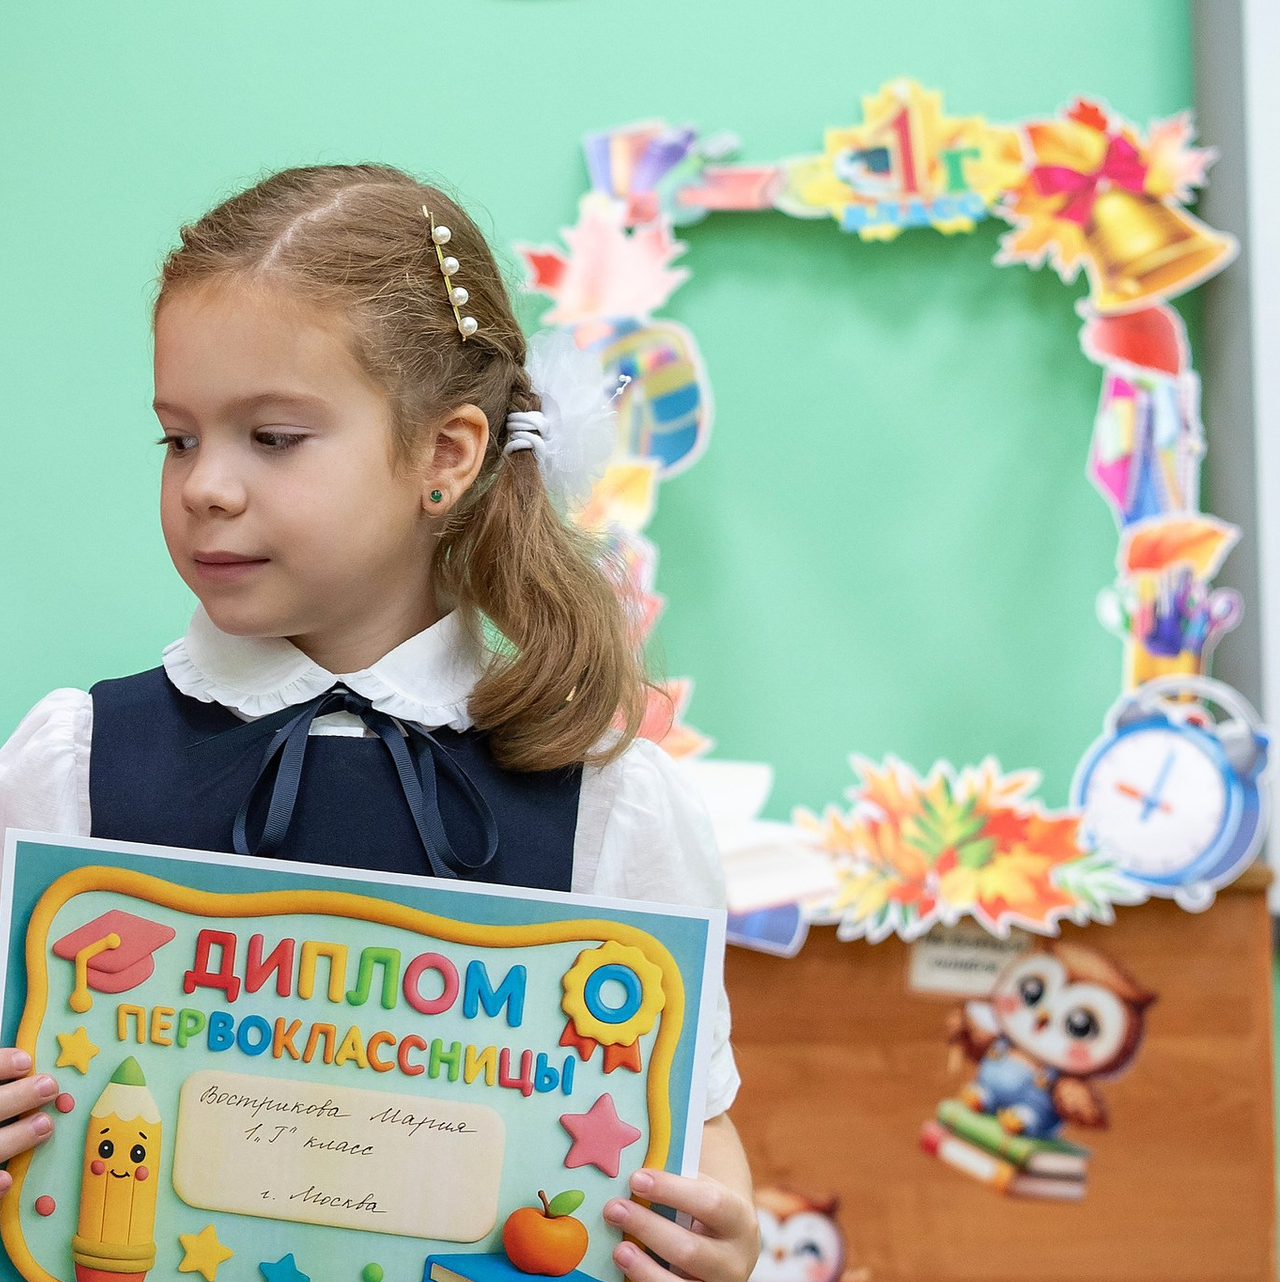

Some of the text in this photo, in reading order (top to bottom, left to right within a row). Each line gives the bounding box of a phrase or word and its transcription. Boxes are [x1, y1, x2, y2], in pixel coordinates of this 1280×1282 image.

[183, 928, 527, 1028] ДИПЛОМ
[116, 1003, 577, 1097] ПЕРВОКЛАССНИЦЫ
[199, 1084, 478, 1137] Вострикова Мария
[303, 1134, 375, 1157] класс
[289, 1184, 388, 1214] Москва
